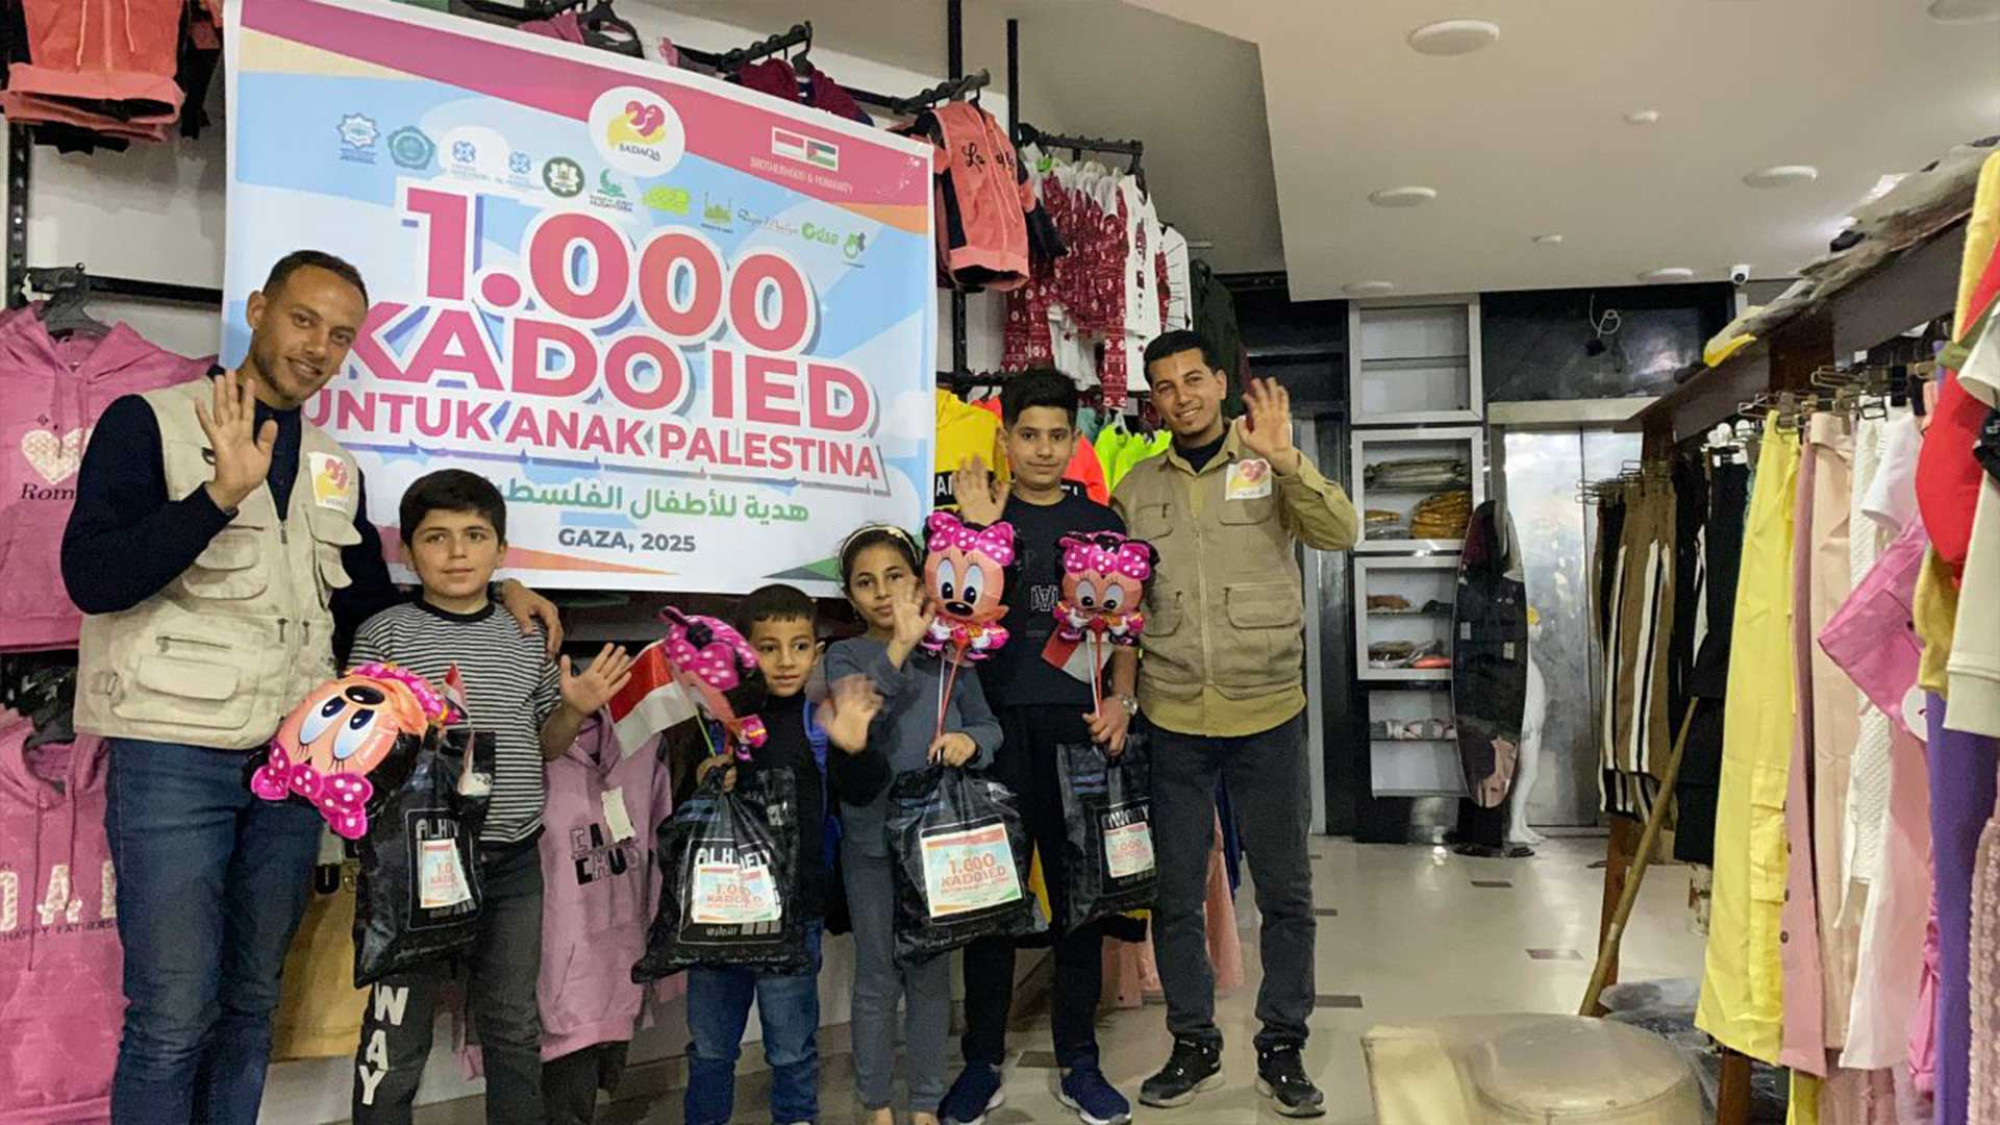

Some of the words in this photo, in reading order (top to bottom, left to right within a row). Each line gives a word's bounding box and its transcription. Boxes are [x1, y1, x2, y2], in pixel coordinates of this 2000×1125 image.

[407, 187, 809, 352] 1.000
[712, 349, 870, 432] IED
[302, 388, 497, 442] UNTUK
[505, 407, 649, 457] ANAK
[660, 423, 879, 480] PALESTINA
[20, 483, 76, 501] Rom
[629, 487, 738, 520] للأطفال
[744, 495, 810, 526] هدية
[558, 528, 635, 554] GAZA,
[641, 533, 696, 552] 2025
[358, 979, 409, 1106] WAY
